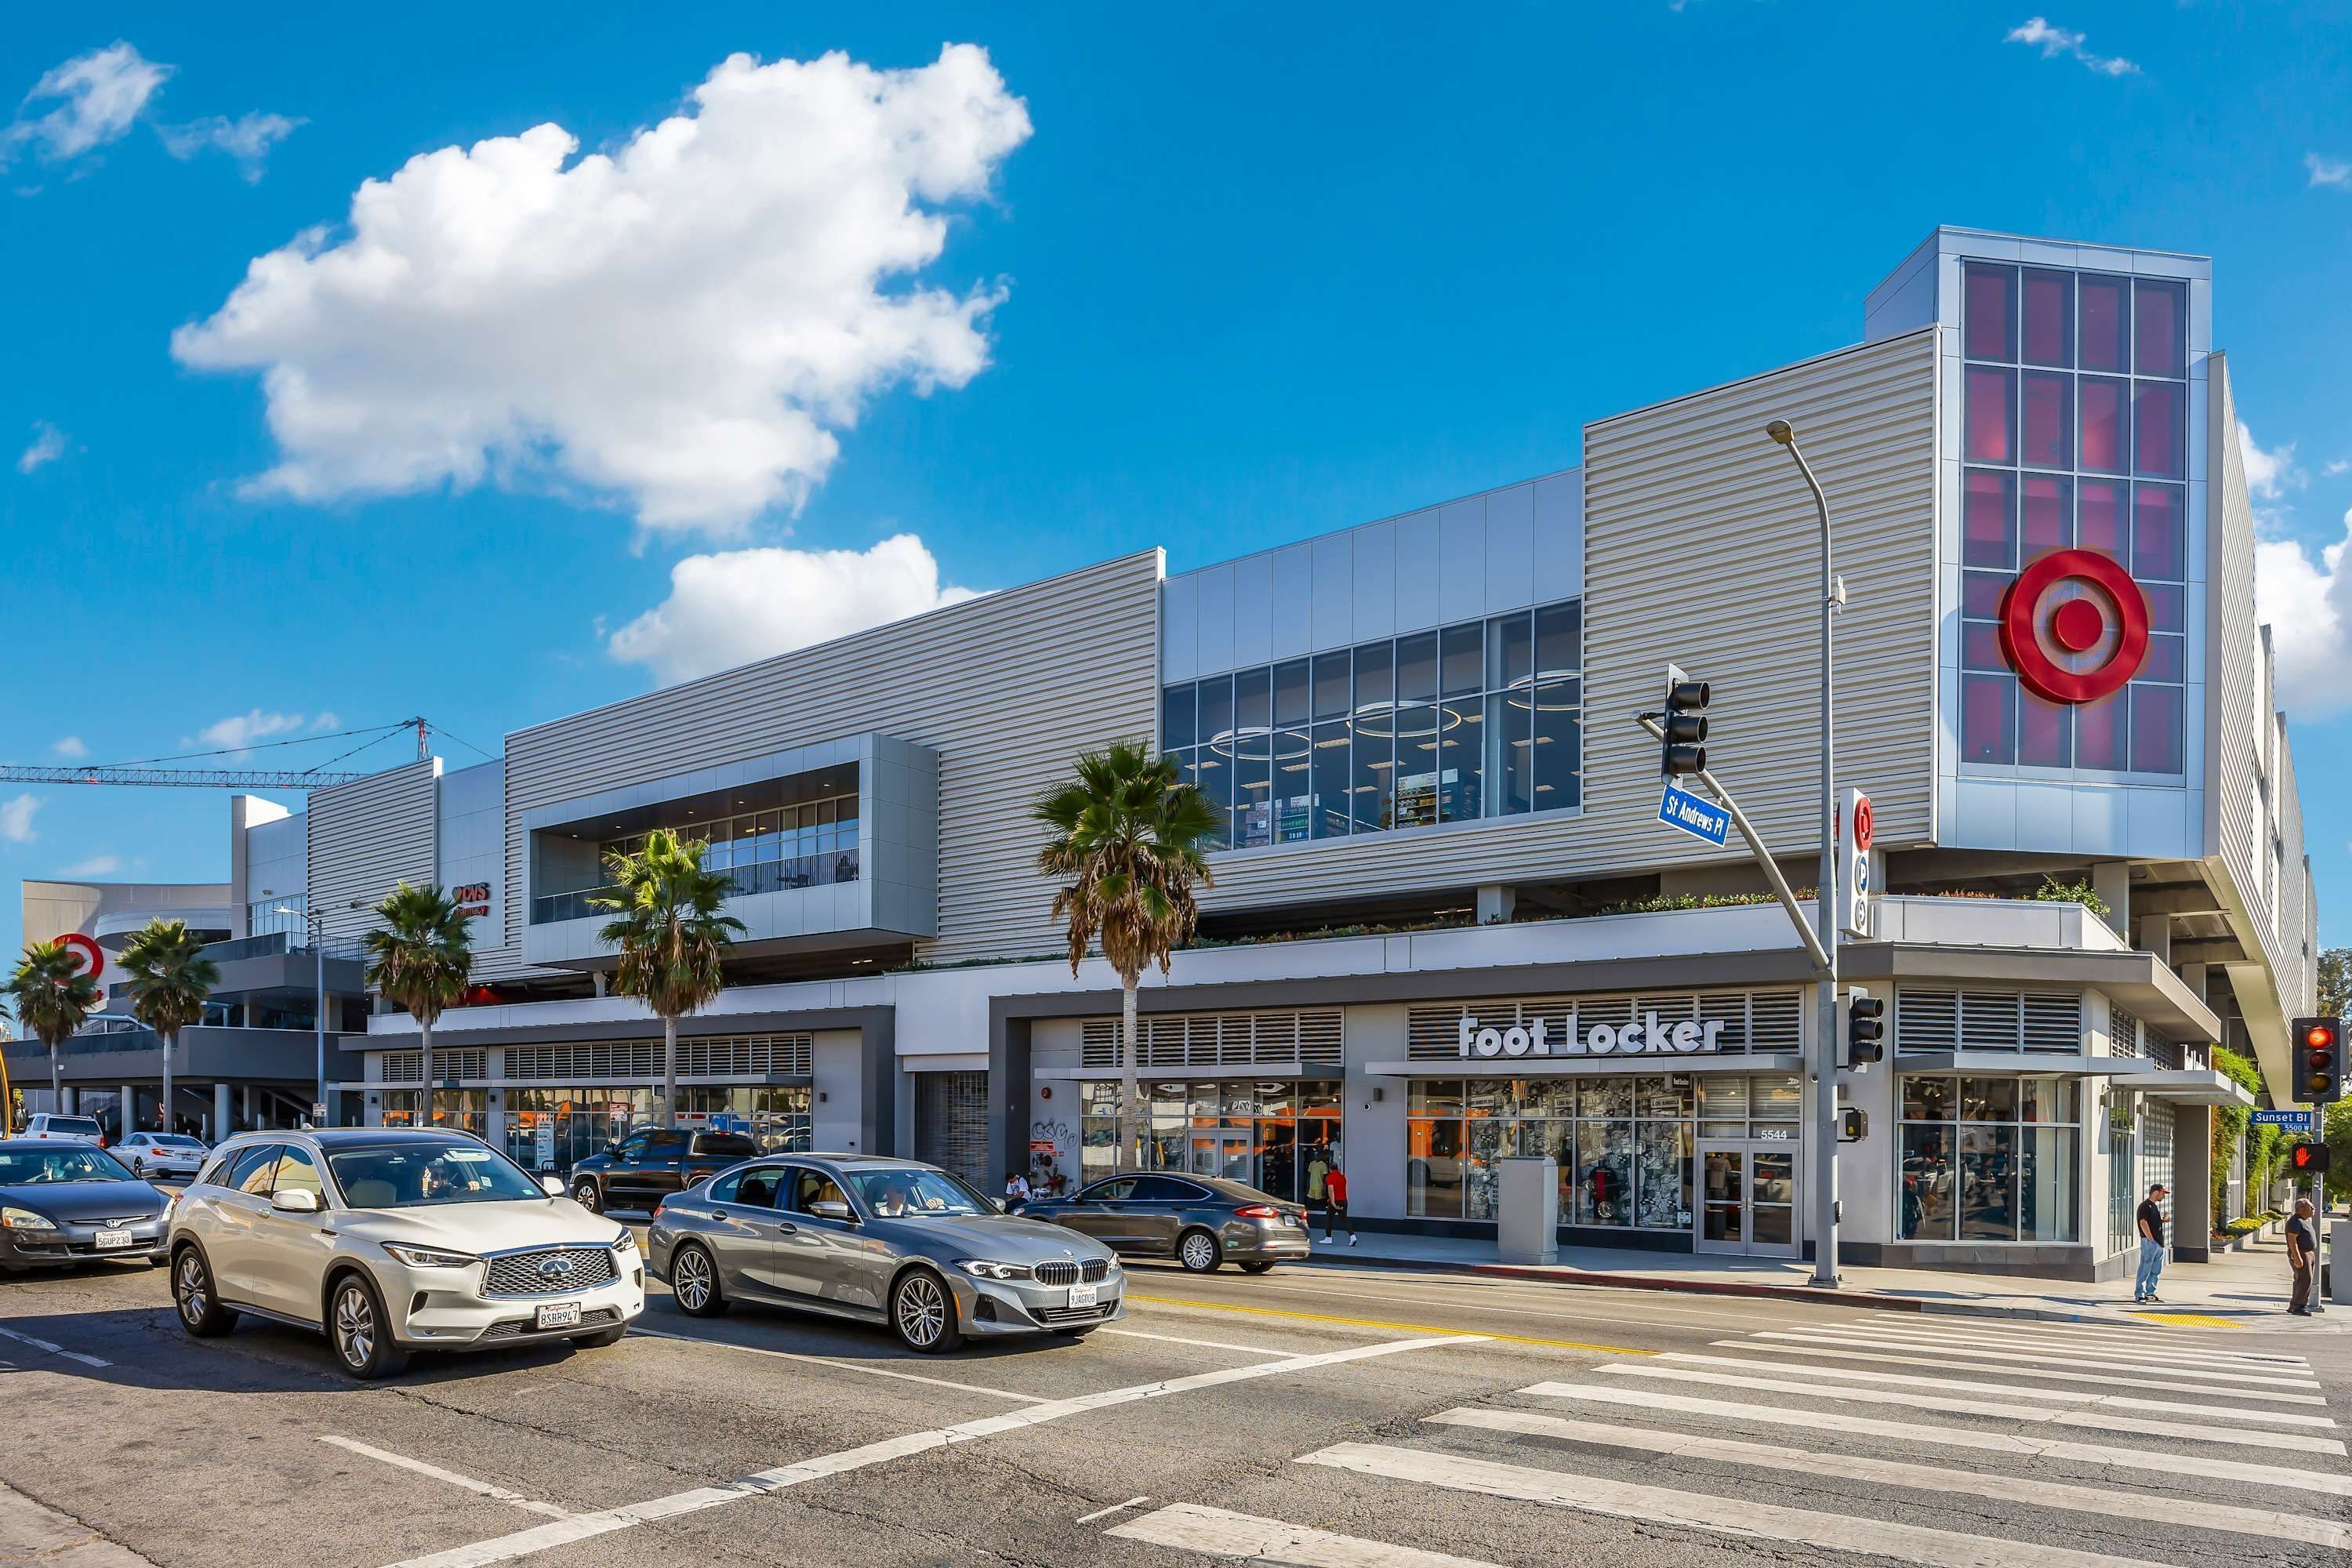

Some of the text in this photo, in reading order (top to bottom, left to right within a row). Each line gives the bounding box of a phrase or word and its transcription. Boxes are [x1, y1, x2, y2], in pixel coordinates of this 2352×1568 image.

[1666, 795, 1725, 837] St Andrews Pl
[463, 884, 489, 902] CVS
[455, 906, 488, 916] harmacy
[1566, 1011, 1725, 1054] Locker
[2256, 1112, 2307, 1122] Sunset Bl
[1761, 1130, 1788, 1140] 5544
